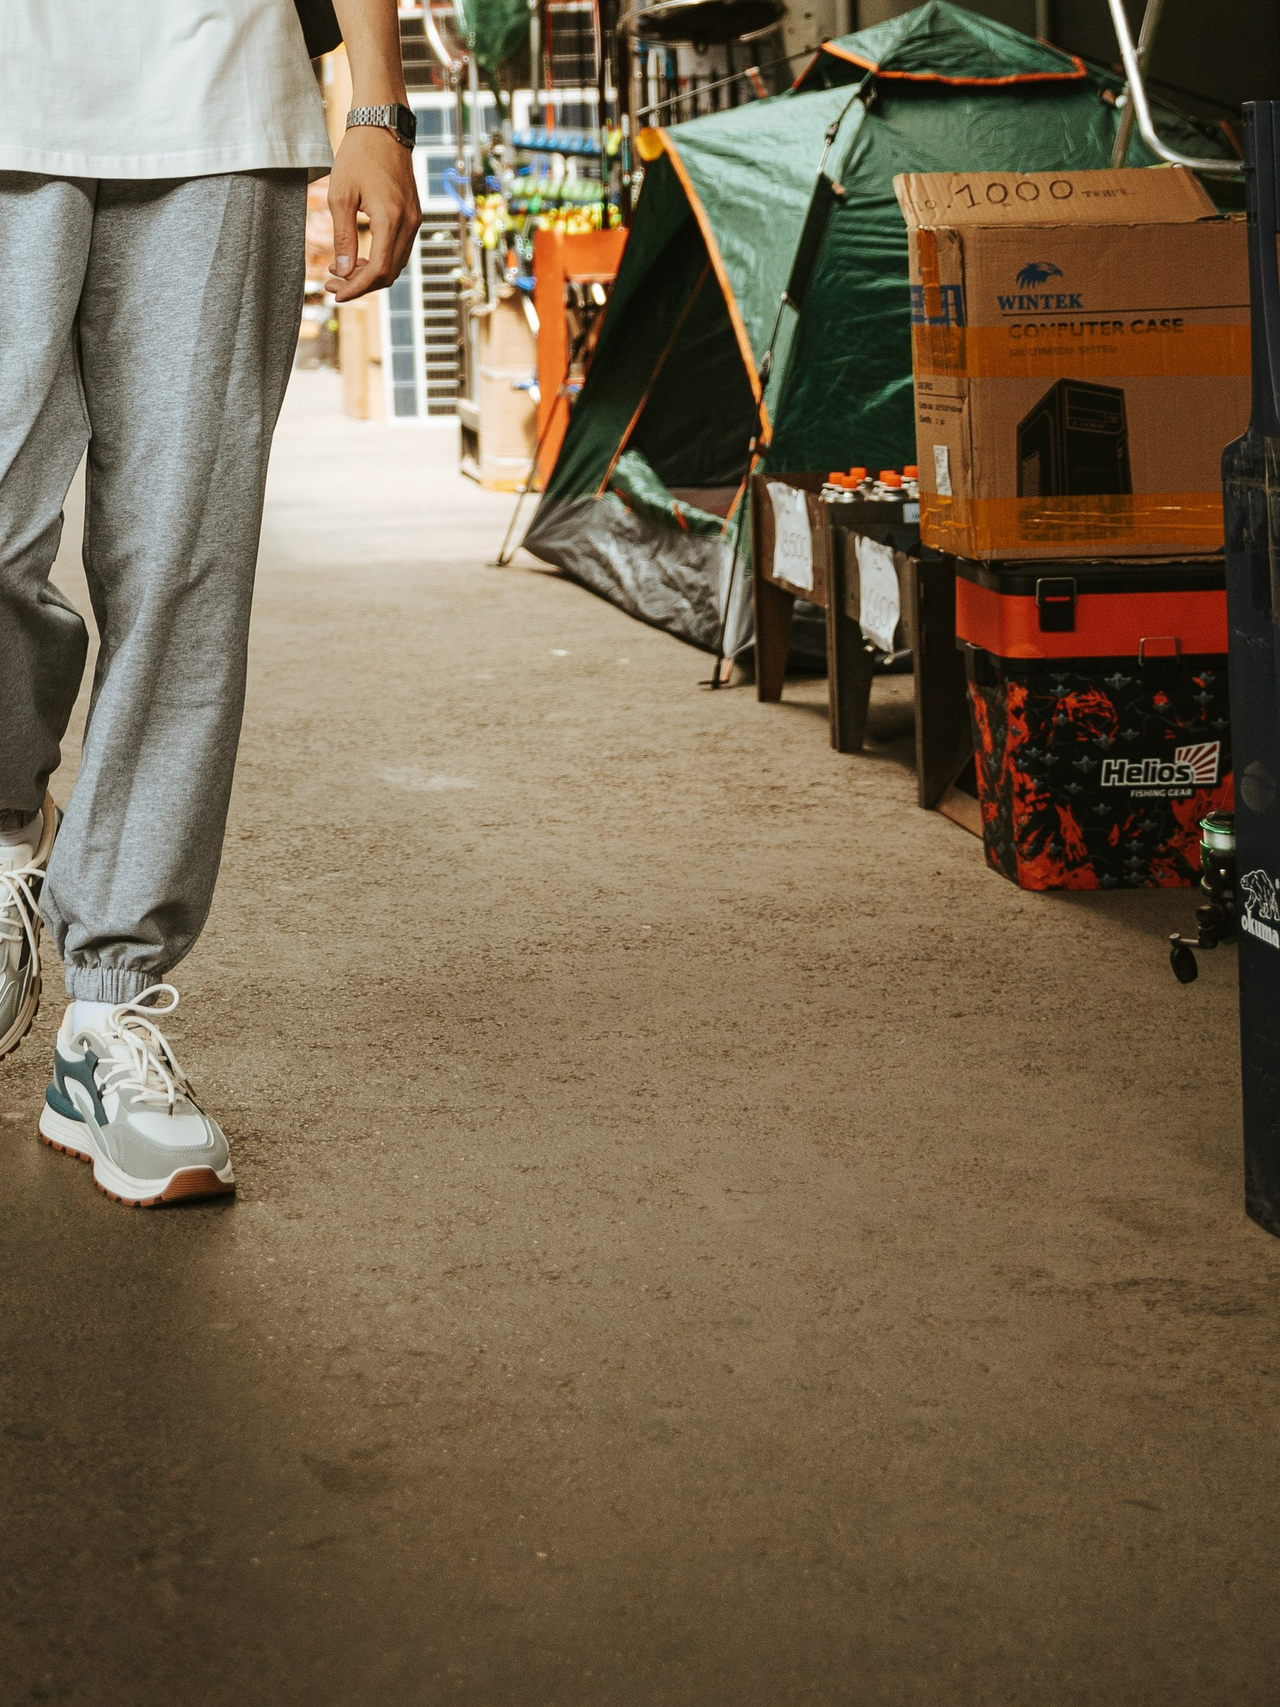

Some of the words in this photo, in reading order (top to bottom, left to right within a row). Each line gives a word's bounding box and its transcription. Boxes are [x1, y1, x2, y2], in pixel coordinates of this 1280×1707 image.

[954, 179, 1074, 209] 1000
[997, 293, 1084, 310] WINTEK
[1008, 320, 1125, 340] COMPUTER
[1130, 317, 1184, 335] CASE
[1100, 758, 1195, 786] Helios
[1130, 788, 1166, 798] FISHING
[1167, 788, 1193, 797] GEAR
[1241, 909, 1280, 949] okuma
